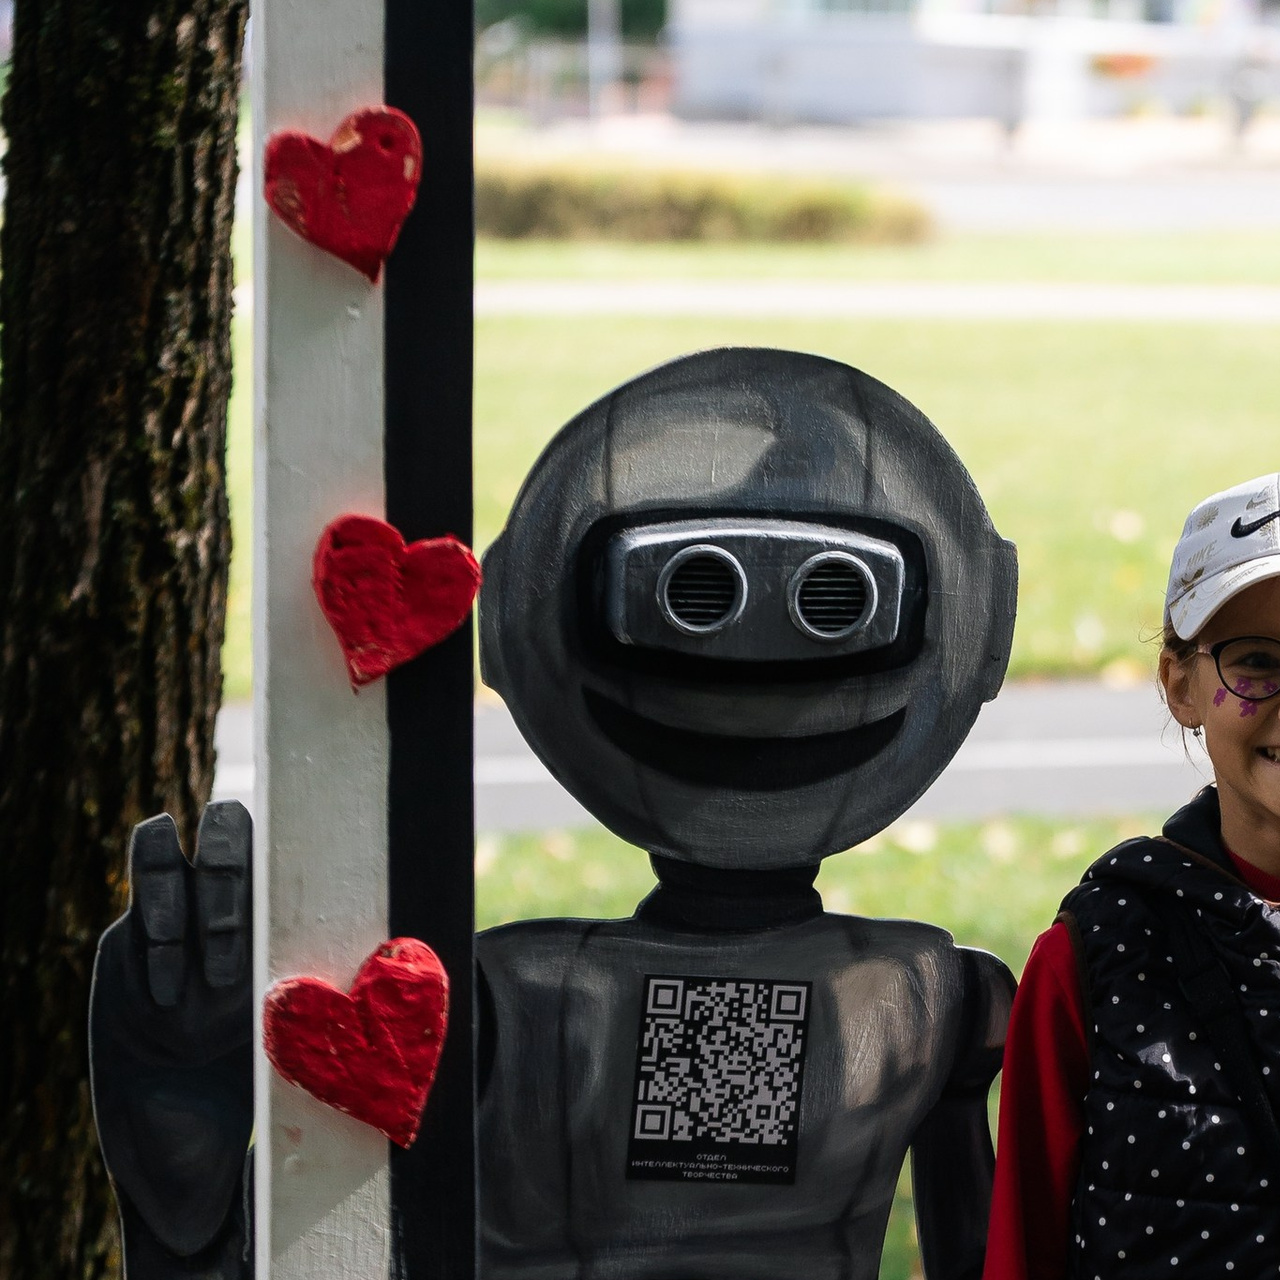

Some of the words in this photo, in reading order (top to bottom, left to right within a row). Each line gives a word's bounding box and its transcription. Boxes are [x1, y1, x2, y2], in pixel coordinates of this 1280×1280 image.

[695, 1153, 727, 1162] ОТДЕЛ
[631, 1160, 789, 1173] ИНТЕЛЛЕКТУАЛЬНО-ТЕХНИЧЕСКОГО
[682, 1171, 738, 1180] ТВОРЧЕСТВА
